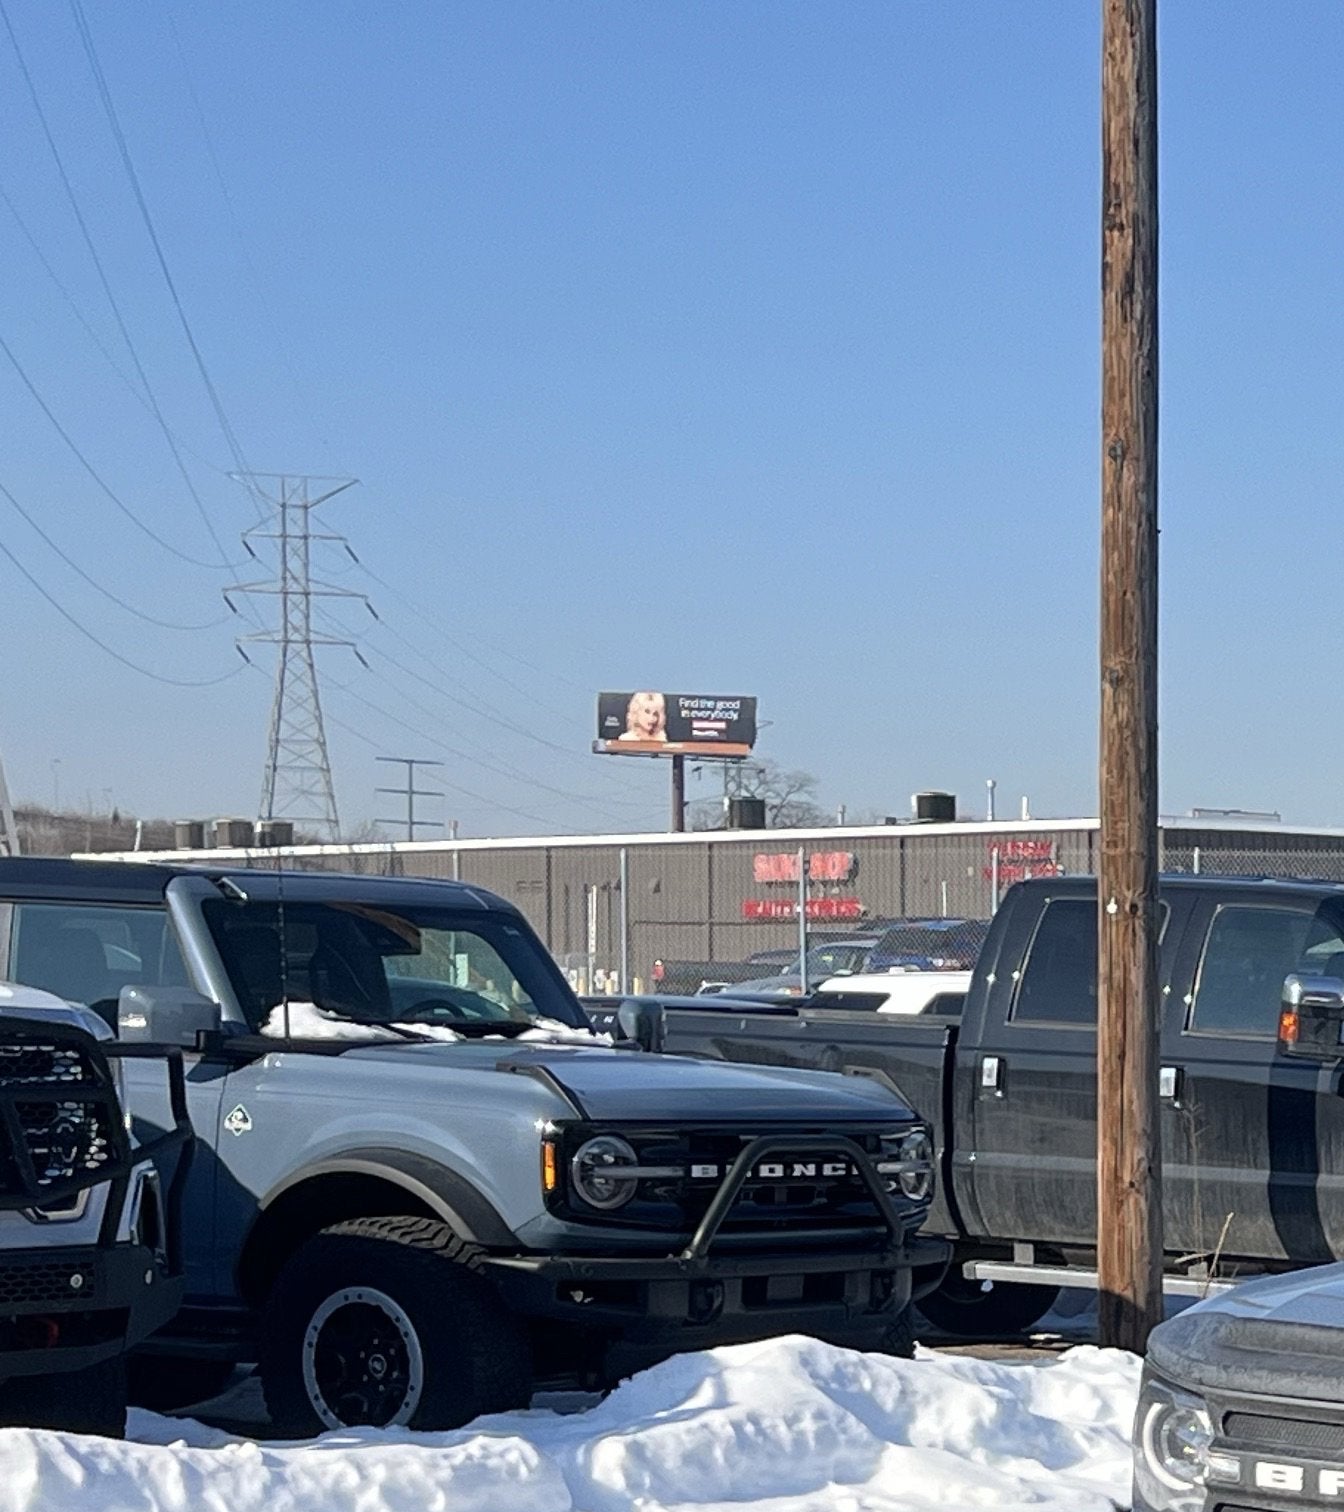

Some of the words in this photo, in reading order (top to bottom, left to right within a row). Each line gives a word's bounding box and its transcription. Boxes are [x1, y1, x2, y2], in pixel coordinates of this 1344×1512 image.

[679, 698, 699, 708] Find
[700, 699, 715, 708] the
[716, 700, 740, 711] good
[690, 1163, 859, 1178] BONC
